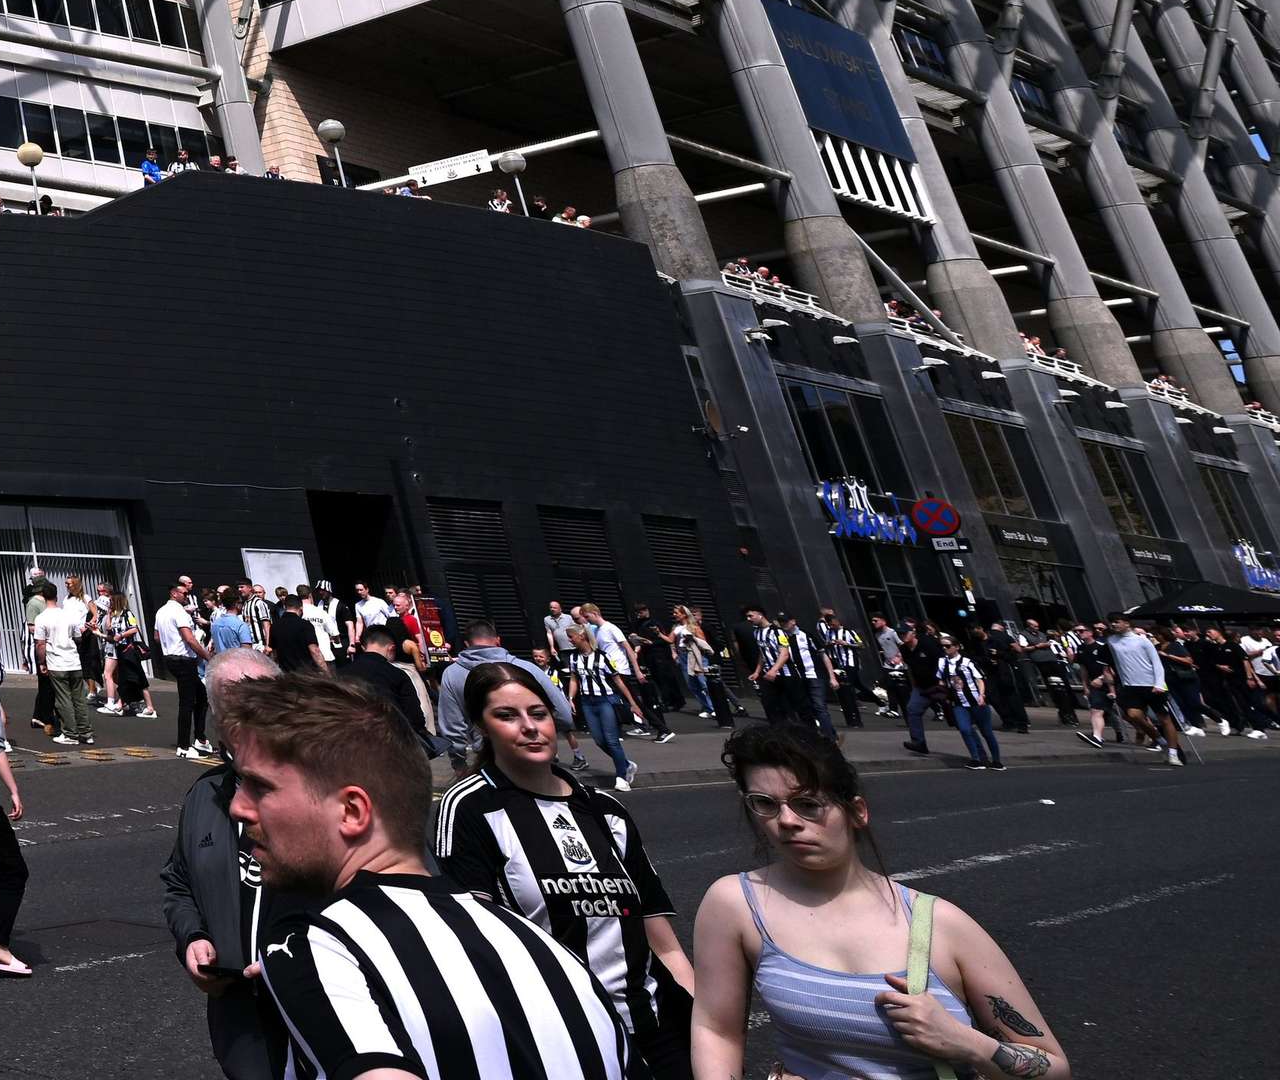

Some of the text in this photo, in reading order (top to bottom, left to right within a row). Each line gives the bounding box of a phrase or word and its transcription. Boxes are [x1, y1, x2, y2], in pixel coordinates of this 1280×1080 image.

[935, 540, 955, 548] End
[552, 823, 577, 832] adidas
[541, 873, 637, 895] northern
